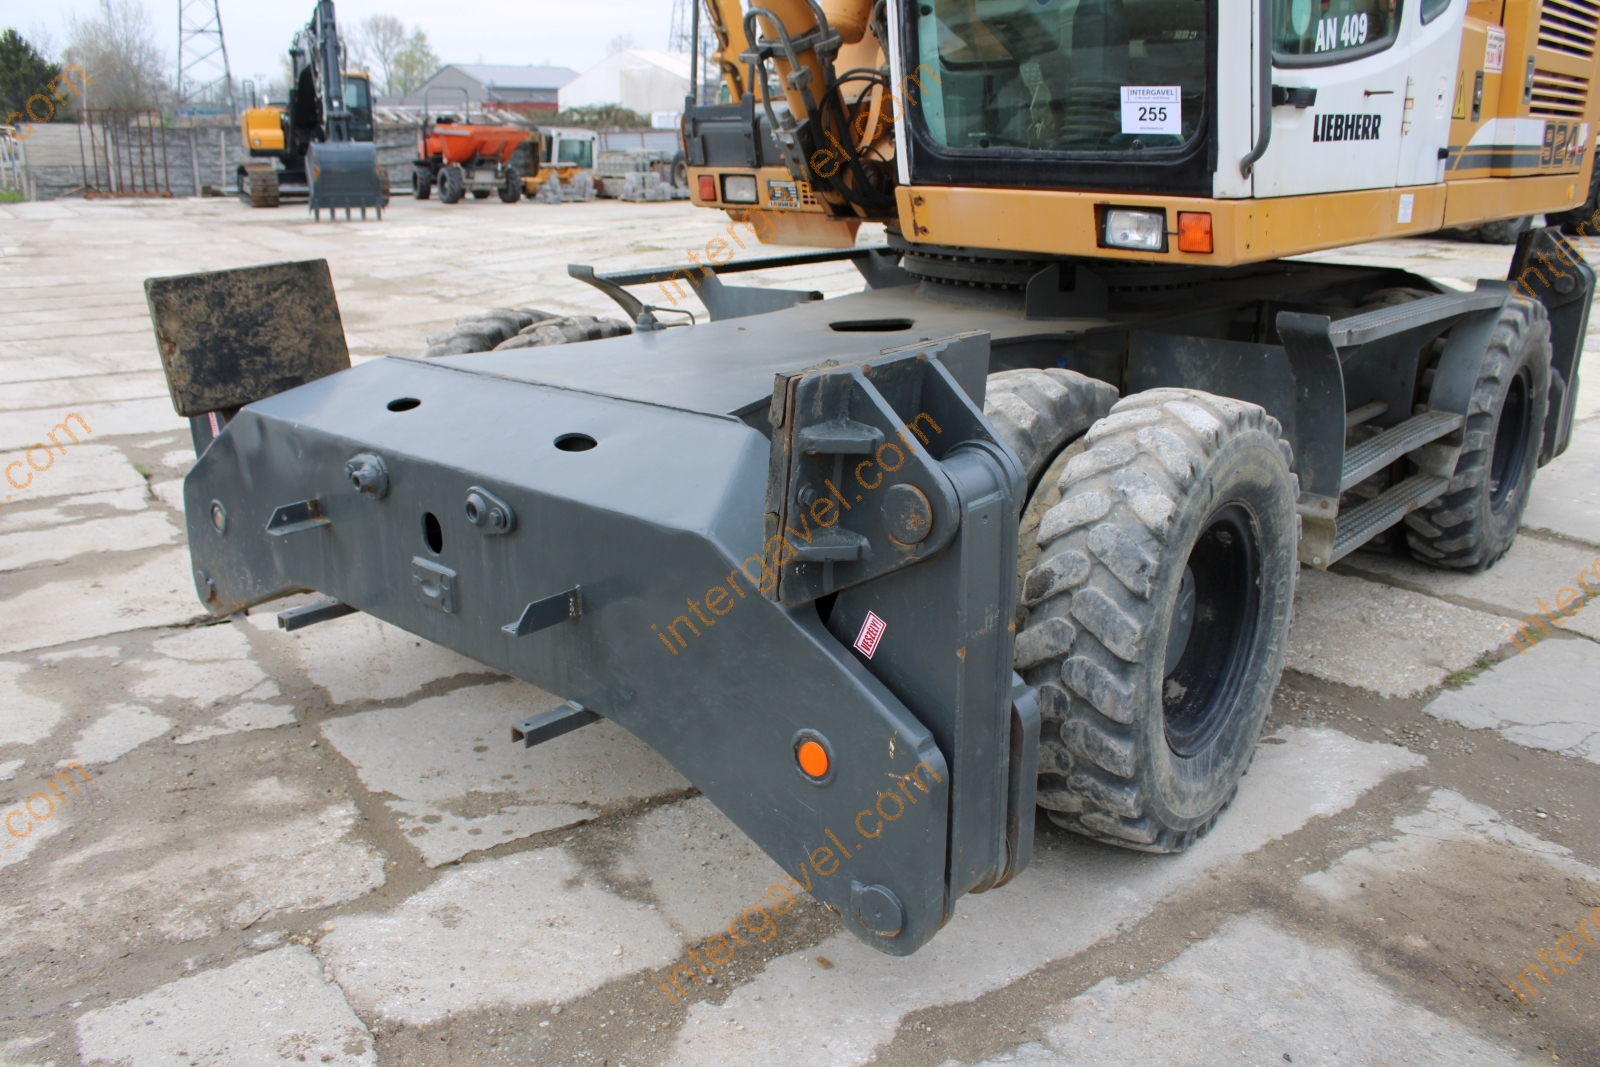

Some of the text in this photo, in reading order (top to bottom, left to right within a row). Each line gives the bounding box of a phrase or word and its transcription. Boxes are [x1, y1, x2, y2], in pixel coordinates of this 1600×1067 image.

[1314, 12, 1368, 53] AN 409
[1138, 106, 1168, 122] 255
[1312, 114, 1382, 143] LIEBHERR
[1541, 121, 1579, 169] 924
[861, 618, 882, 651] VESZÉLY!
